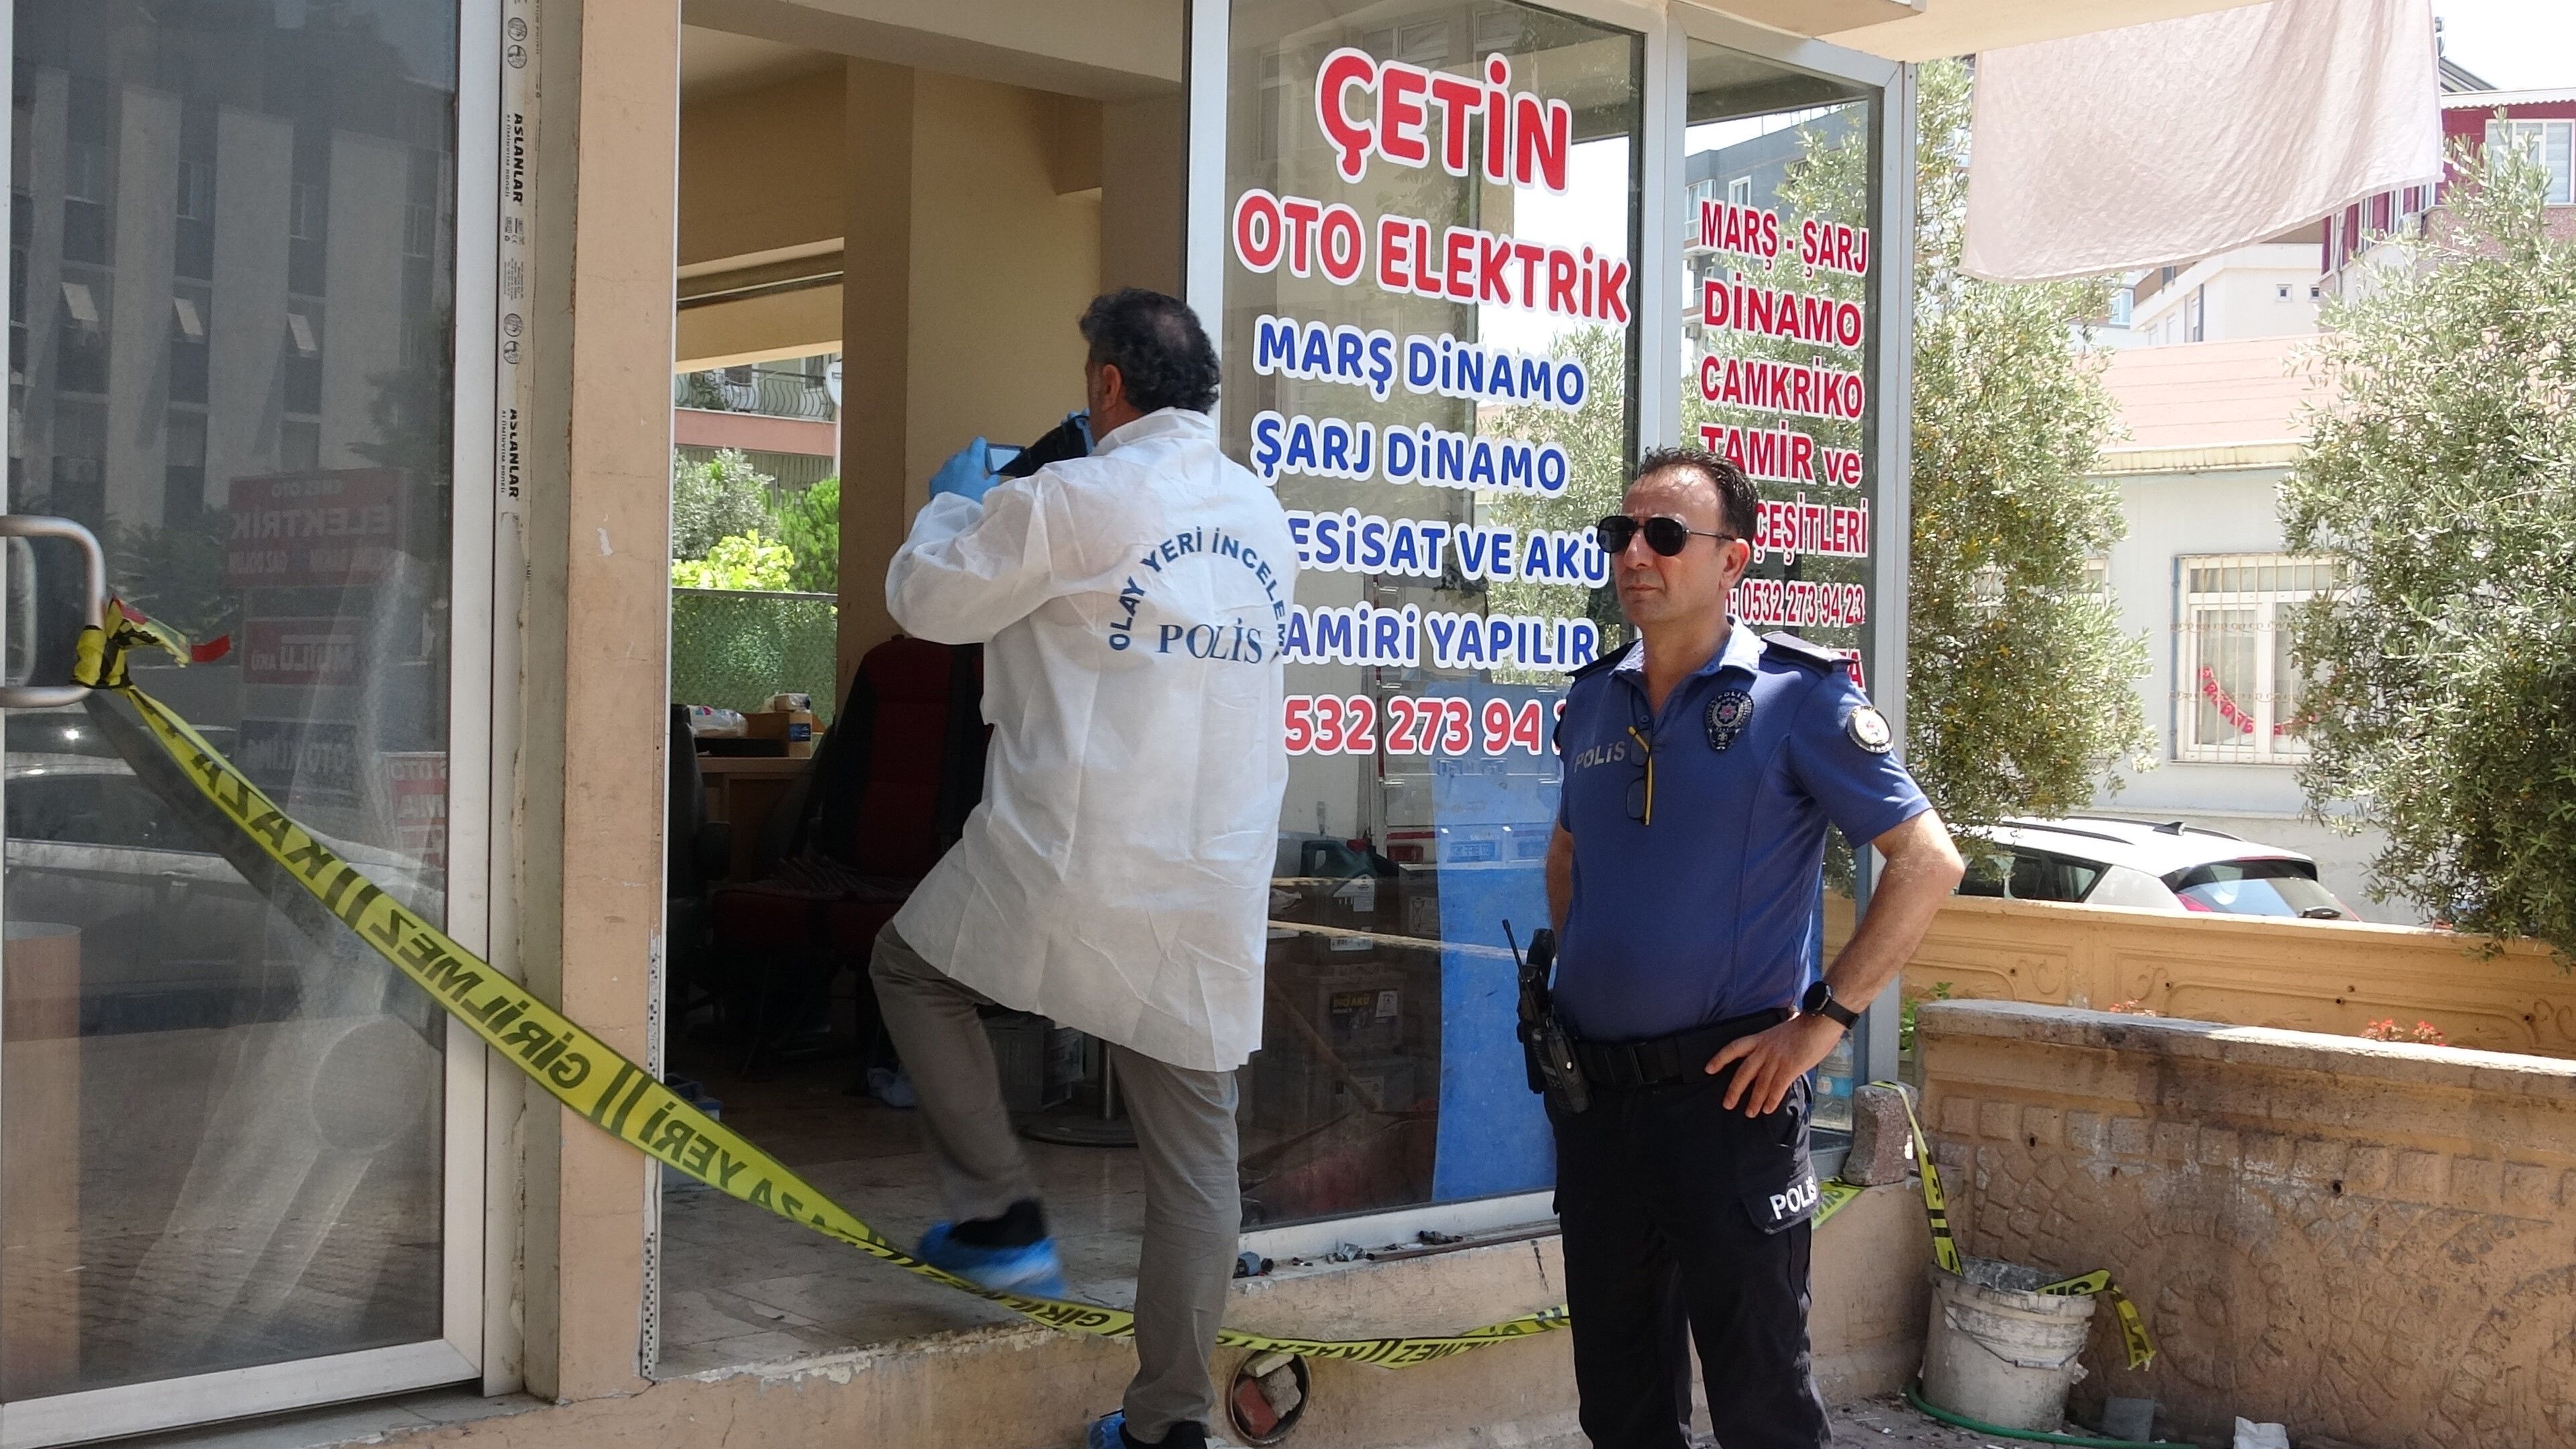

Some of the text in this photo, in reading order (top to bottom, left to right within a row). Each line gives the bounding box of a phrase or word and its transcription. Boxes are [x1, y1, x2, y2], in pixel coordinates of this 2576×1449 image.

[1320, 54, 1568, 192] ÇETİN
[513, 113, 523, 203] ASLANLAR
[1237, 195, 1628, 323] OTO ELEKTRİK
[1701, 201, 1778, 270] MARŞ
[1802, 220, 1867, 278] ŞARJ
[1703, 272, 1862, 346] DİNAMO
[1258, 322, 1393, 394] MARŞ
[1701, 356, 1864, 419] CAMKRİKO
[509, 408, 519, 498] ASLANLAR
[1256, 419, 1371, 478] ŞARJ
[1701, 421, 1861, 485] TAMİR ve
[1287, 515, 1606, 582] ESİSAT VE AKÜ
[1754, 492, 1867, 563] ÇEŞİTLERİ
[1108, 526, 1287, 661] OLAY YERİ İNCELEM
[1742, 582, 1782, 621] 0532
[1786, 584, 1818, 623] 273
[1821, 586, 1840, 625] 94
[1845, 587, 1864, 624] 23
[1155, 617, 1263, 664] POLİS
[1282, 608, 1596, 665] AMİRİ YAPILIR
[1284, 699, 1375, 752] 532
[1388, 700, 1470, 753] 273
[1485, 702, 1540, 752] 94
[1573, 740, 1626, 773] POLİS
